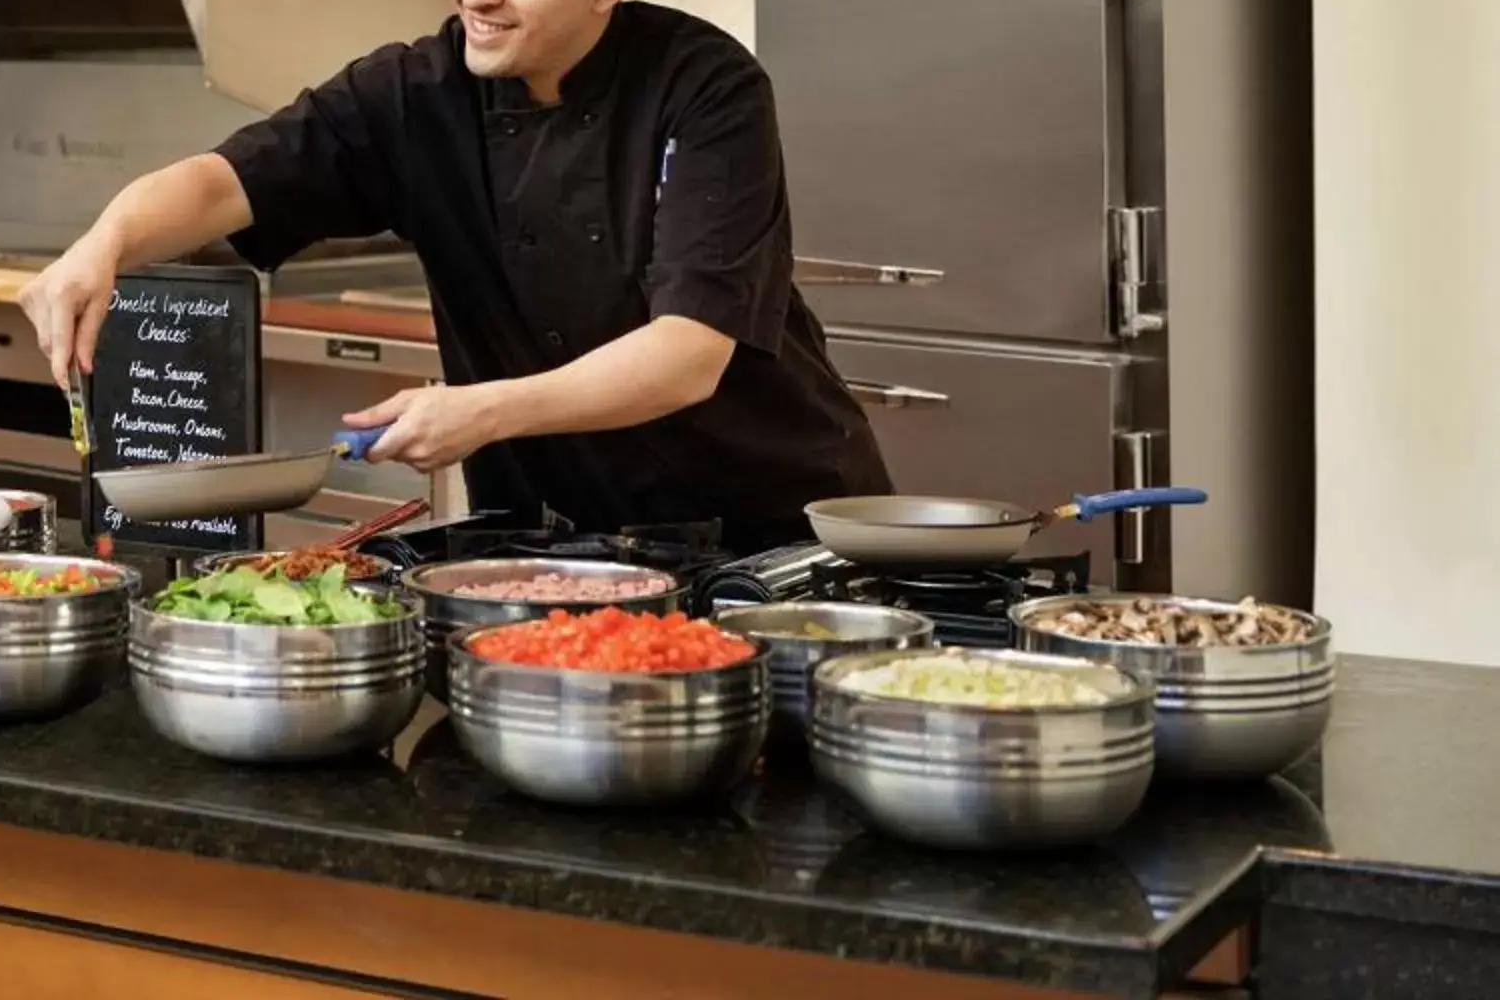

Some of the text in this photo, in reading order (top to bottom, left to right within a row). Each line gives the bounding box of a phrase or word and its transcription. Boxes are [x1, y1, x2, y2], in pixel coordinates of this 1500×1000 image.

[163, 292, 230, 325] Ingredient
[129, 360, 208, 390] Ham, Sausage,
[112, 412, 227, 441] Mushrooms, Onions,
[115, 437, 172, 462] Tomatoes,
[104, 505, 123, 531] Egg
